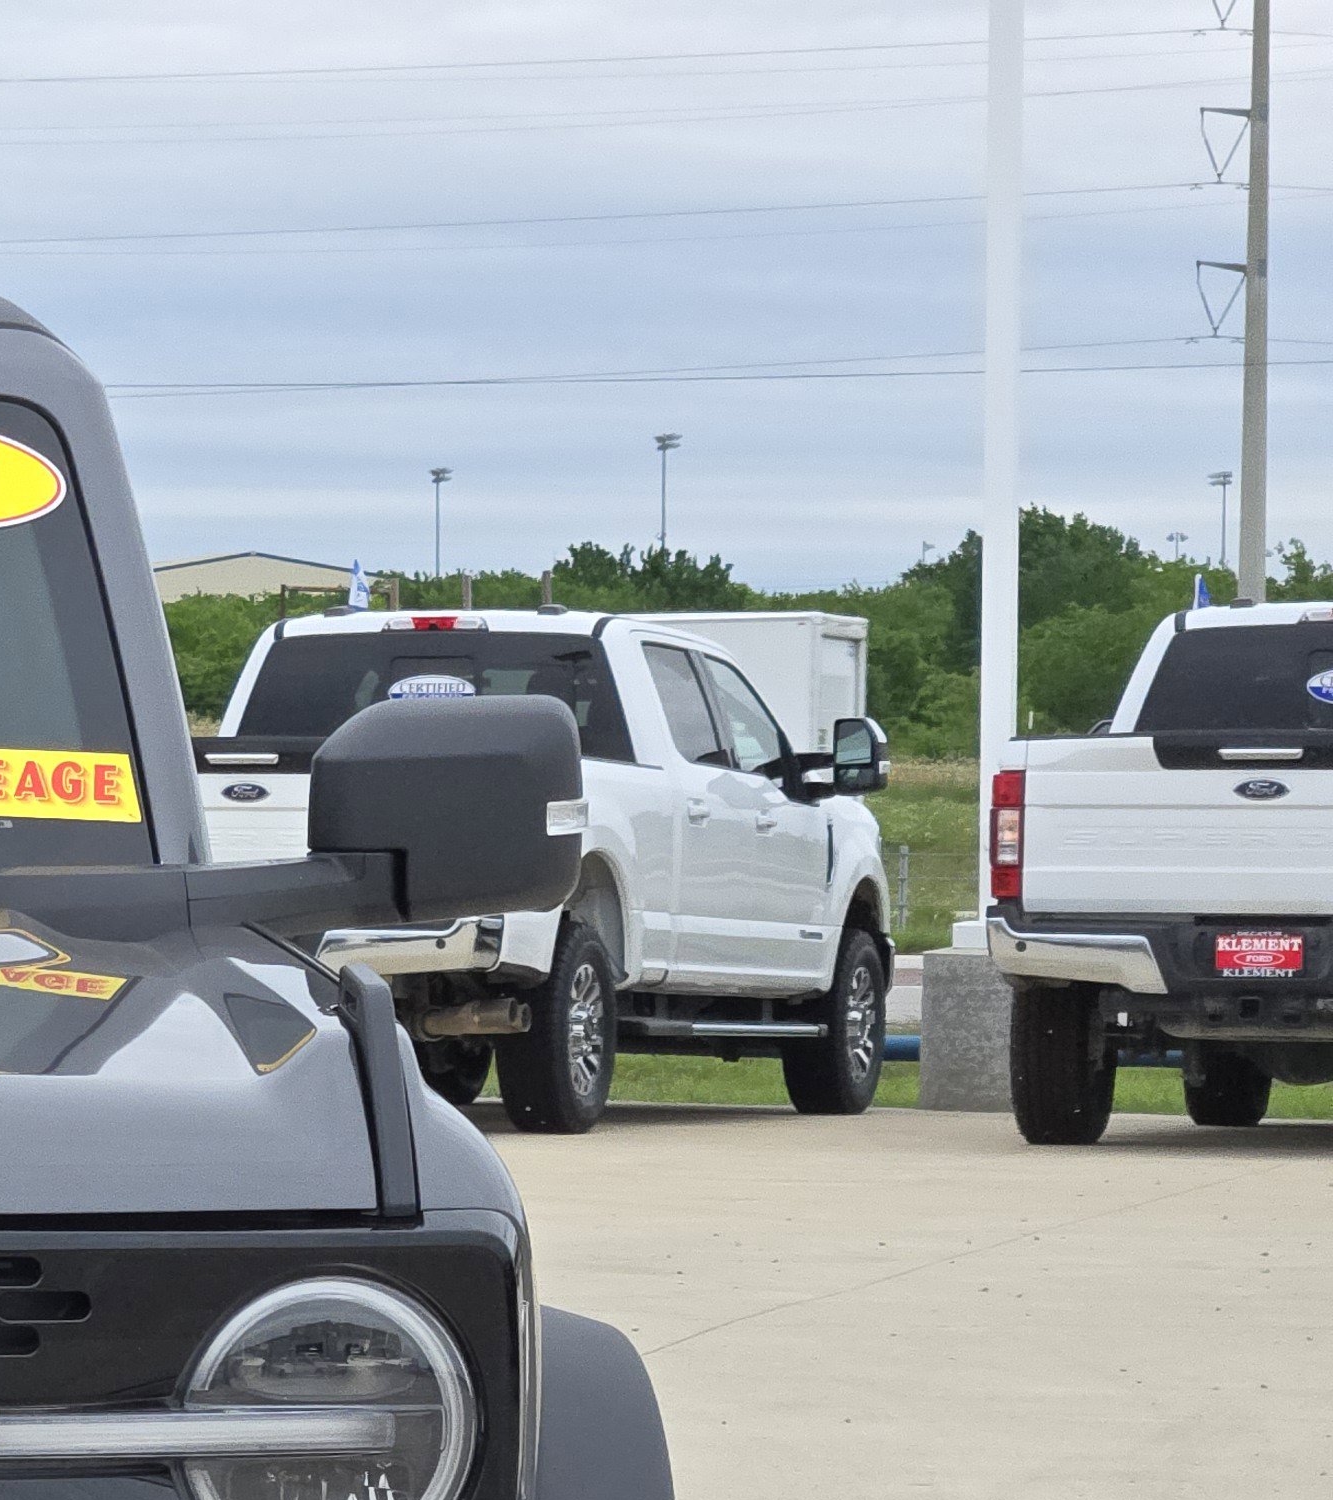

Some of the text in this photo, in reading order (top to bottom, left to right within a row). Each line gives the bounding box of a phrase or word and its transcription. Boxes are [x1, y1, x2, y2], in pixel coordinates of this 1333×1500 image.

[399, 682, 466, 693] CERTIFIED
[1218, 937, 1302, 951] KLEMENT
[1245, 954, 1273, 963] FORD
[1222, 967, 1296, 977] KLEMENT
